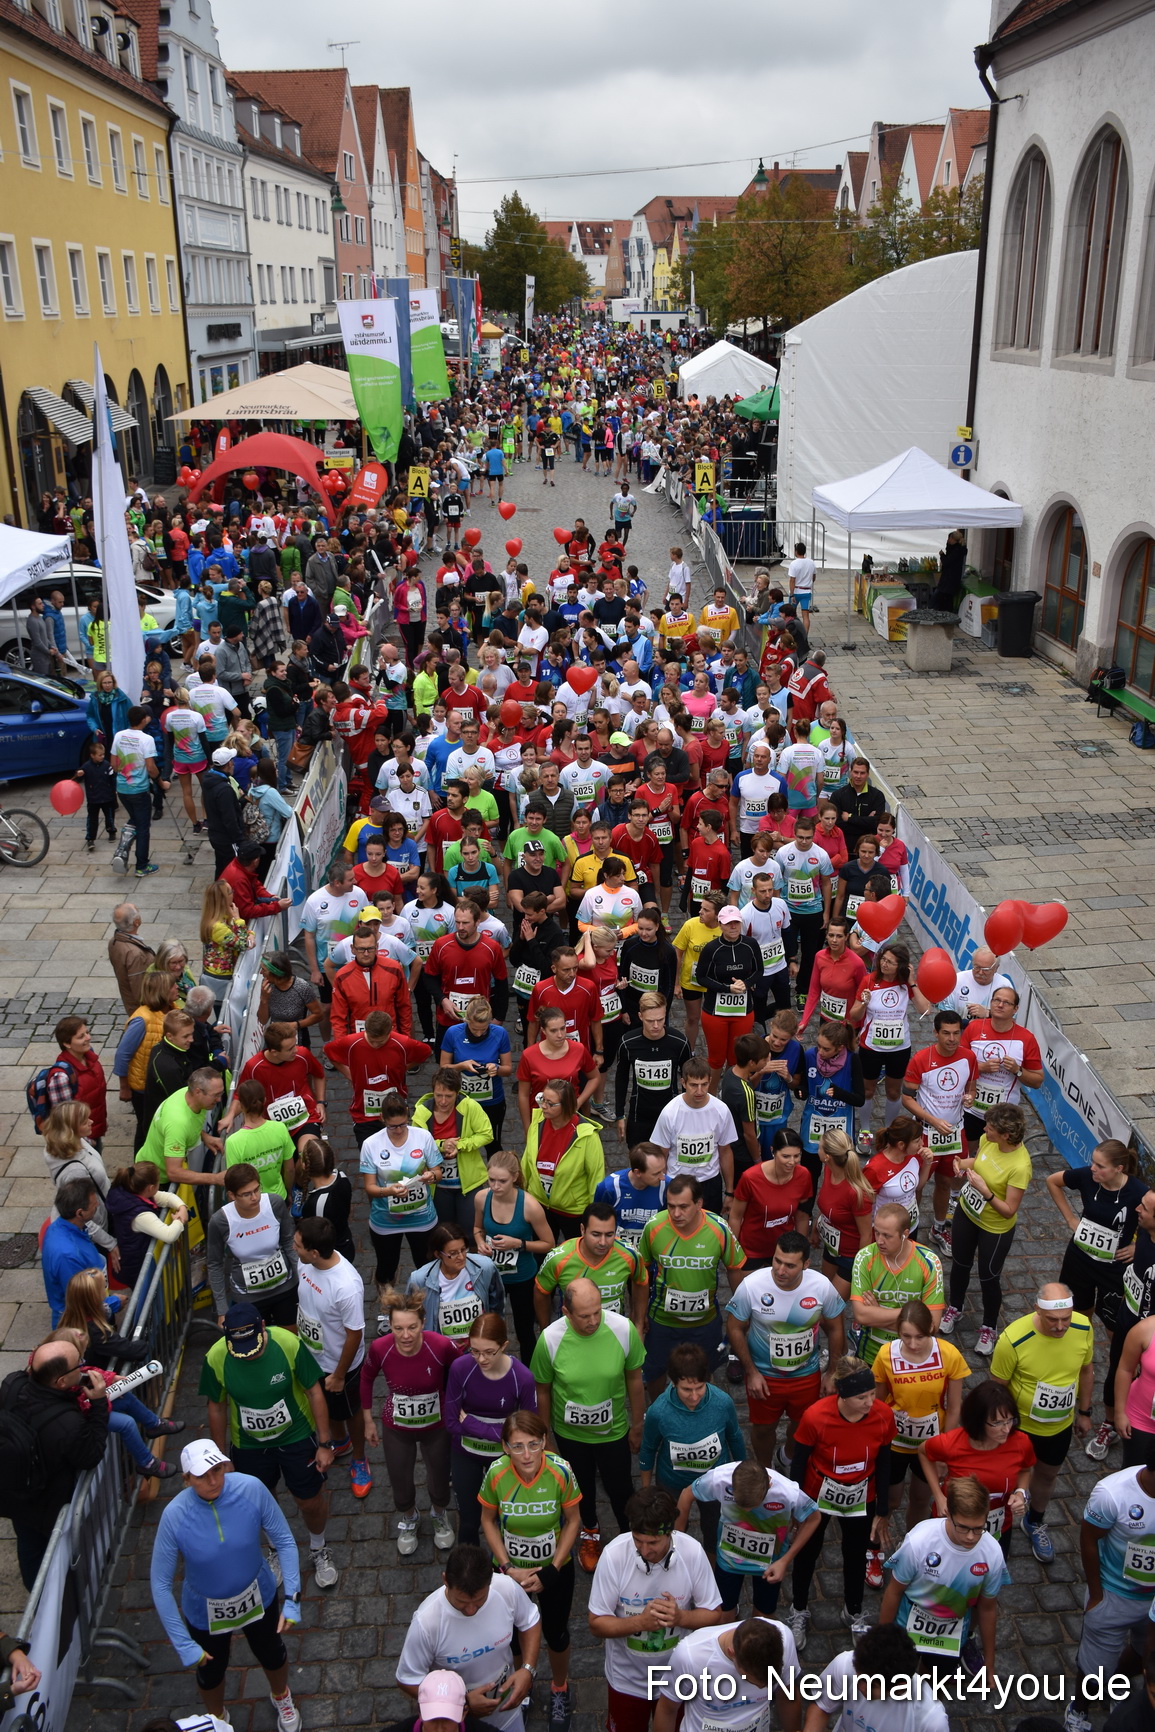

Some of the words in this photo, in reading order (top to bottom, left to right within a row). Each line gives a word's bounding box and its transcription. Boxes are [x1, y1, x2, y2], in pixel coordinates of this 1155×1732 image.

[657, 385, 663, 394] B
[413, 476, 424, 491] A
[700, 472, 711, 487] A
[0, 733, 15, 743] RTL
[17, 732, 54, 742] Neumarkt
[573, 785, 594, 796] 5025
[746, 802, 766, 811] 2535
[790, 883, 812, 894] 5156
[763, 943, 782, 960] 5312
[516, 969, 537, 985] 5185
[632, 970, 656, 984] 5339
[453, 1000, 469, 1010] 512
[720, 994, 745, 1006] 5003
[821, 997, 844, 1013] 5157
[875, 1027, 902, 1039] 5017
[639, 1068, 669, 1080] 5148
[808, 1067, 817, 1078] 8
[461, 1079, 490, 1093] 5324
[1046, 1047, 1096, 1126] RAIL.ONE
[975, 1088, 1001, 1104] 5161
[272, 1101, 304, 1122] 5062
[756, 1099, 782, 1112] 5160
[932, 1130, 958, 1145] 5051
[681, 1141, 711, 1155] 5021
[441, 1166, 459, 1178] 221
[1079, 1228, 1113, 1250] 5151
[491, 1251, 515, 1262] 002
[659, 1255, 715, 1270] BOCK
[244, 1263, 257, 1271] PARTL
[249, 1260, 283, 1285] 5109
[600, 1284, 625, 1299] CK
[456, 1299, 476, 1308] Neumarkt
[669, 1300, 706, 1311] 5173
[443, 1304, 480, 1325] 5008
[787, 1334, 808, 1342] Neumarkt
[774, 1339, 811, 1357] 5164
[106, 1371, 144, 1398] bmw-lau
[270, 1372, 287, 1384] AOK
[894, 1376, 917, 1385] MAX
[919, 1372, 944, 1383] BÖGL
[1037, 1385, 1054, 1395] PARTL
[1038, 1392, 1074, 1409] 5340
[256, 1407, 279, 1416] Neumarkt
[397, 1401, 436, 1416] 5187
[566, 1404, 581, 1412] PARTL
[582, 1405, 606, 1413] Neumarkt
[247, 1411, 286, 1430] 5023
[570, 1409, 609, 1425] 5320
[896, 1420, 936, 1438] 5174
[473, 1441, 496, 1451] Natalie
[688, 1441, 712, 1450] Neumarkt
[676, 1445, 718, 1461] 5028
[686, 1460, 711, 1468] Claudia
[824, 1487, 864, 1505] 5067
[500, 1498, 557, 1515] BOCK
[723, 1524, 741, 1533] PARTL
[742, 1530, 768, 1541] Neumarkt
[505, 1535, 520, 1543] PARTL
[521, 1535, 547, 1545] Neumarkt
[726, 1531, 771, 1555] 5130
[508, 1541, 551, 1559] 5200
[1129, 1546, 1147, 1554] PARTL
[1132, 1554, 1155, 1570] 53
[228, 1591, 252, 1604] Neumarkt
[213, 1597, 257, 1620] 5341
[913, 1616, 958, 1636] 5007
[919, 1636, 945, 1647] Florian
[447, 1645, 495, 1664] RÖDL
[703, 1723, 725, 1732] PARTL
